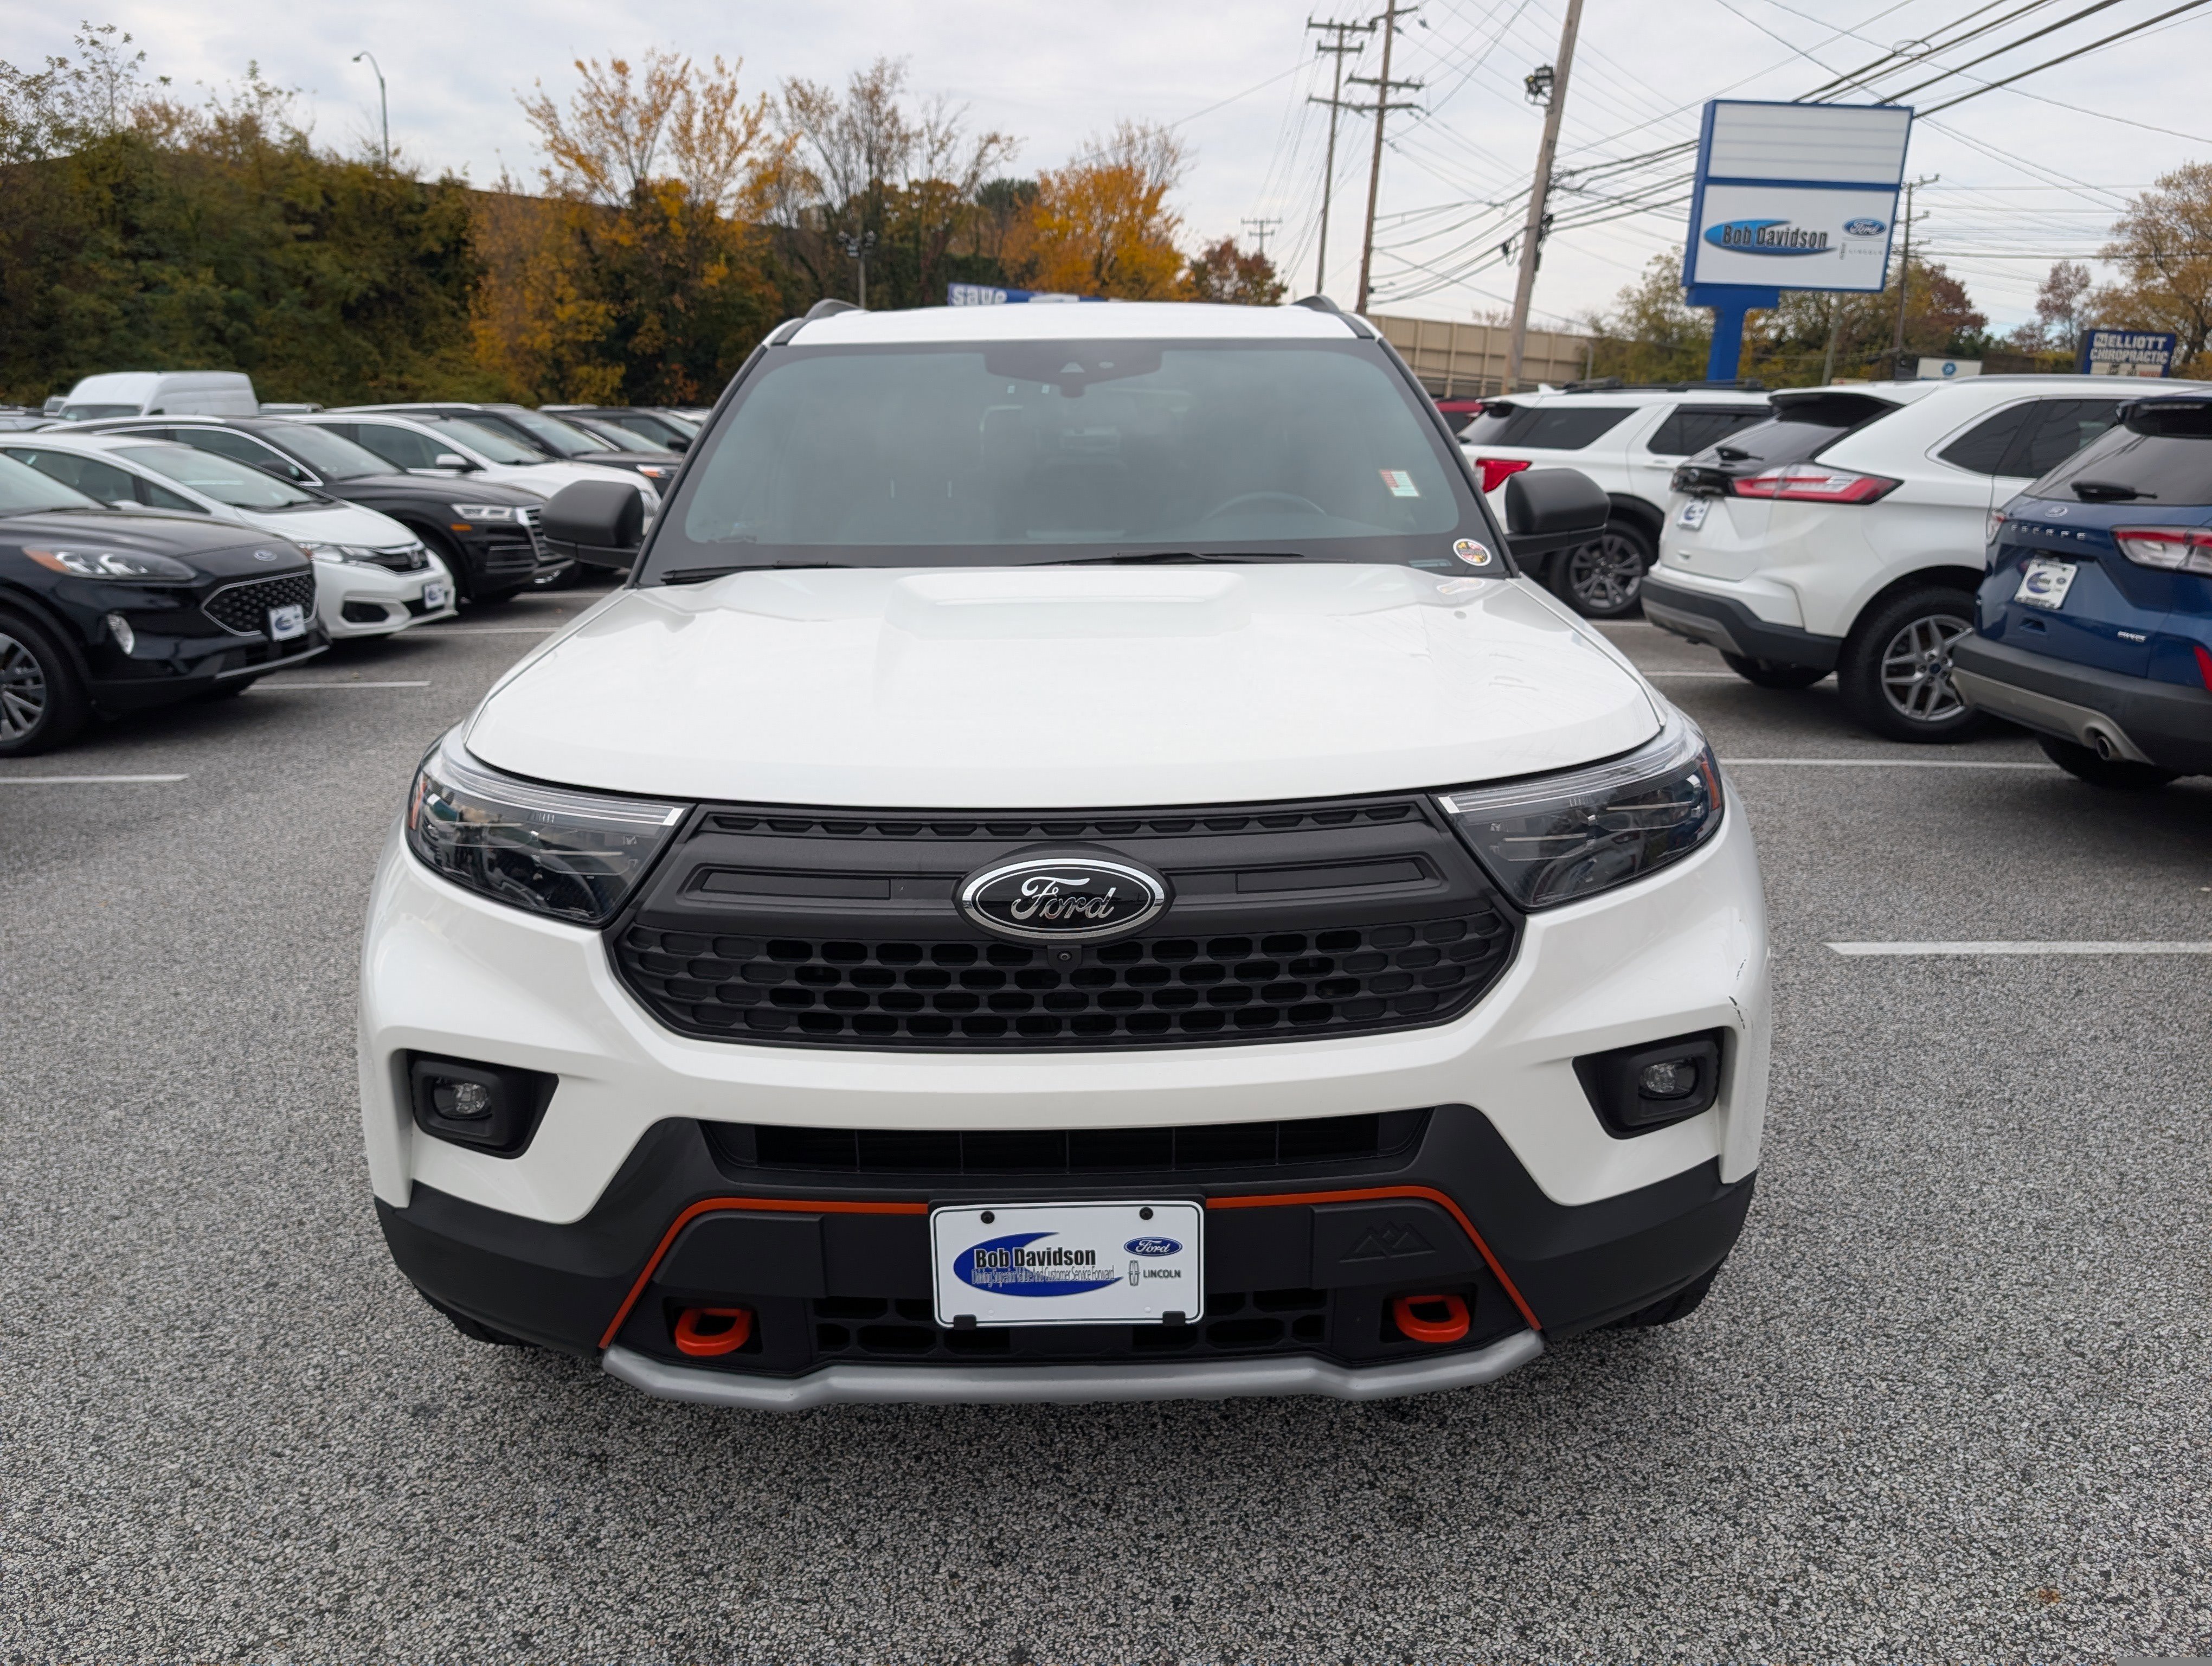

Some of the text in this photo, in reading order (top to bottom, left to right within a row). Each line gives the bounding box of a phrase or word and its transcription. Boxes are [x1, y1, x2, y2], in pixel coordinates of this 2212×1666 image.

[1849, 220, 1880, 234] Ford
[1722, 225, 1829, 249] Bob Davidson
[2107, 334, 2167, 350] ELLIOTT
[2089, 348, 2169, 364] CHIROPRACTIC
[2011, 524, 2086, 540] ESCAPE
[1011, 876, 1117, 920] Ford
[1135, 1239, 1171, 1253] Ford
[975, 1247, 1096, 1268] Bob Davidson
[1044, 1266, 1070, 1281] Customer
[1071, 1266, 1091, 1280] Service
[1091, 1265, 1115, 1280] Forward
[1143, 1270, 1181, 1278] LINCOLN
